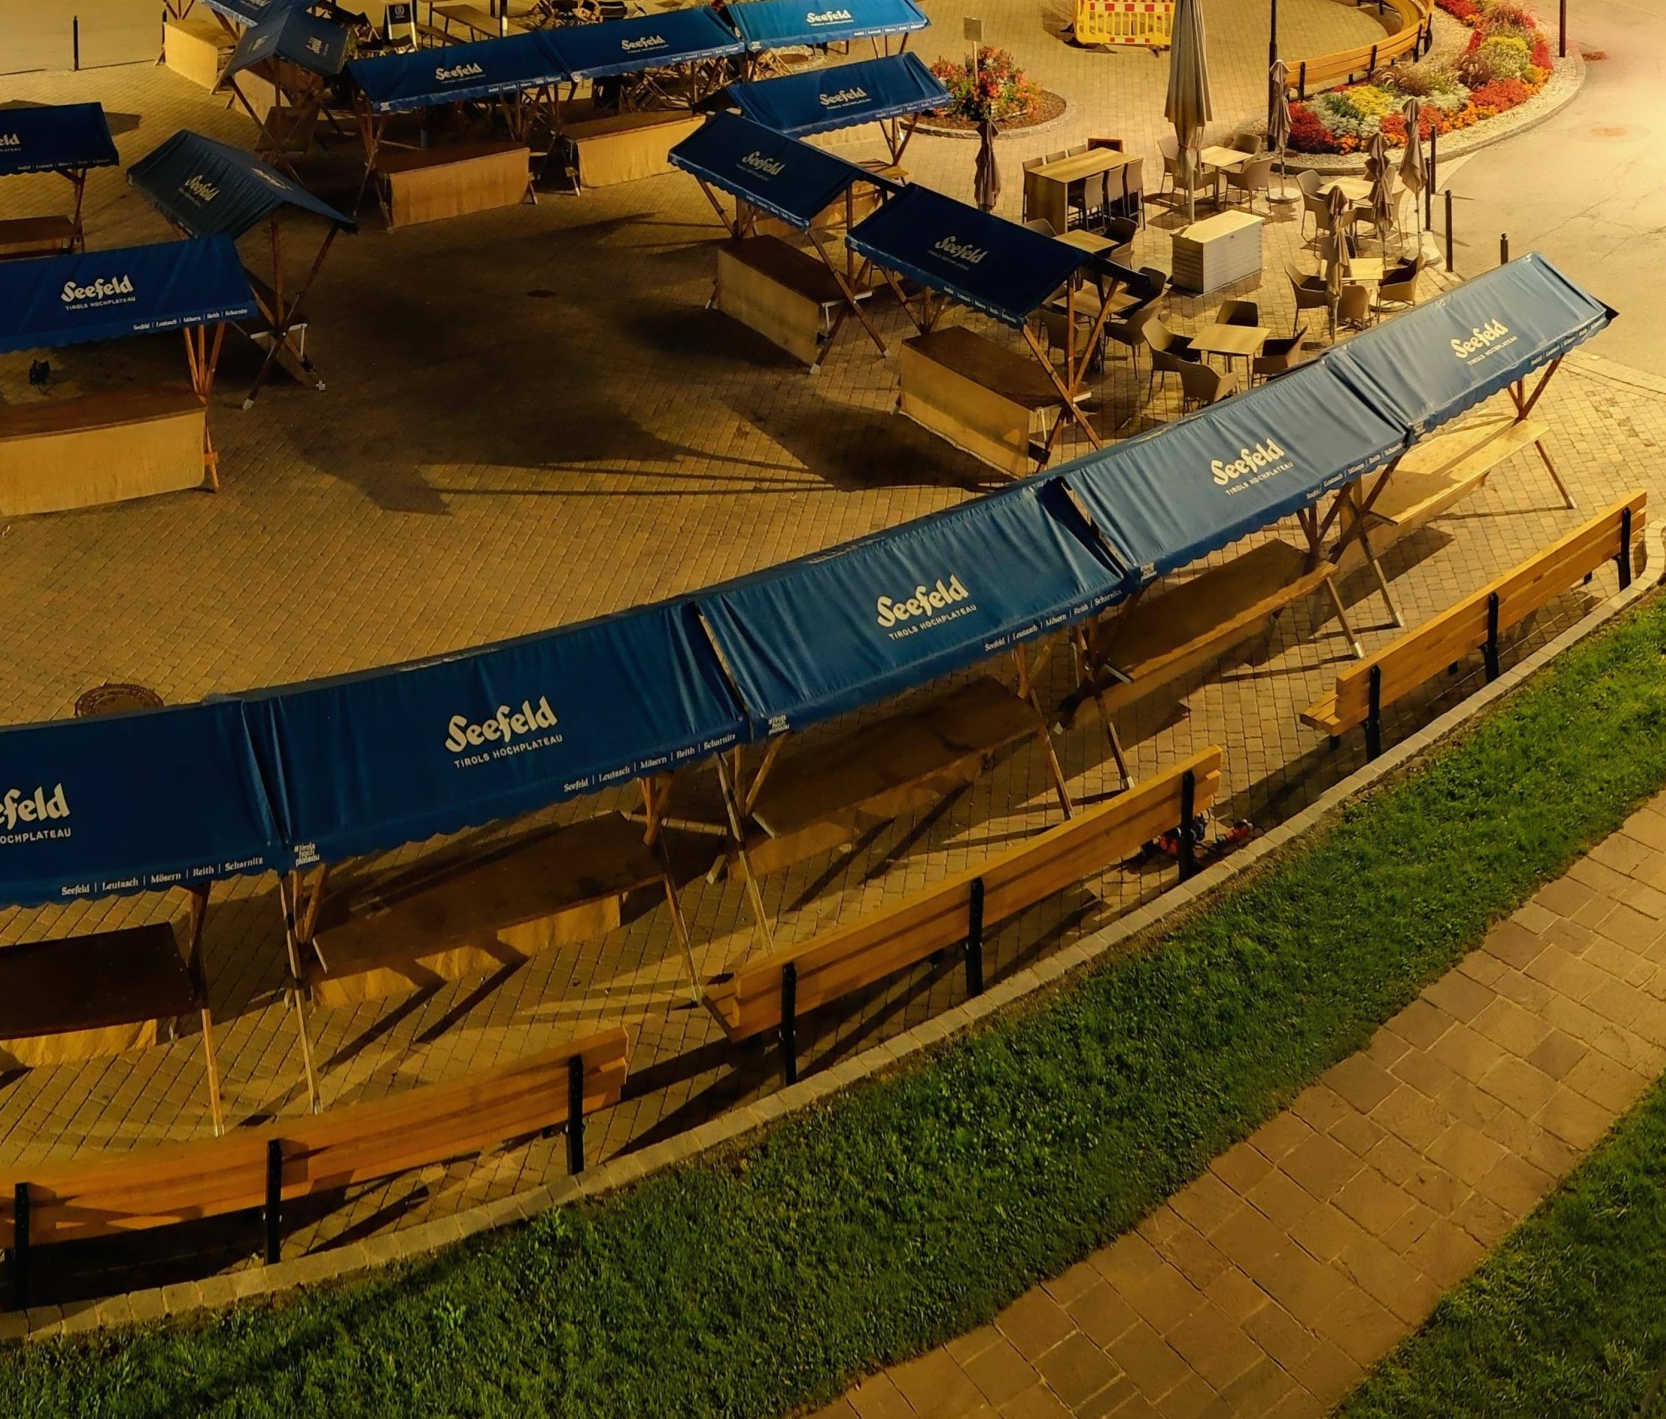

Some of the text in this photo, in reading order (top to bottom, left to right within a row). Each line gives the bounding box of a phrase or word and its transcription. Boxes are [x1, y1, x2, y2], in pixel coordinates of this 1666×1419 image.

[806, 9, 852, 24] Seefeld
[621, 35, 666, 50] Seefeld
[435, 63, 483, 81] Seefeld
[819, 87, 867, 106] Seefeld
[741, 151, 786, 176] Seefeld
[935, 235, 988, 265] Seefeld
[61, 274, 134, 303] Seefeld
[1451, 319, 1509, 359] Seefeld
[1210, 437, 1285, 486] Seefeld
[1225, 460, 1294, 496] TIROLS HOCHPLATEAU
[877, 574, 969, 628] Seefeld
[888, 604, 977, 641] TIROLS HOCHPLATEAU
[1013, 624, 1038, 641] Leutasch
[445, 695, 558, 753] Seefeld
[453, 733, 564, 769] TIROLS HOCHPLATEAU
[563, 777, 589, 793] Seefeld
[598, 765, 630, 783] Leutasch
[676, 746, 696, 761] Reith
[61, 856, 263, 897] Seefeld Leutasch Mösern Reith Scharnitz
